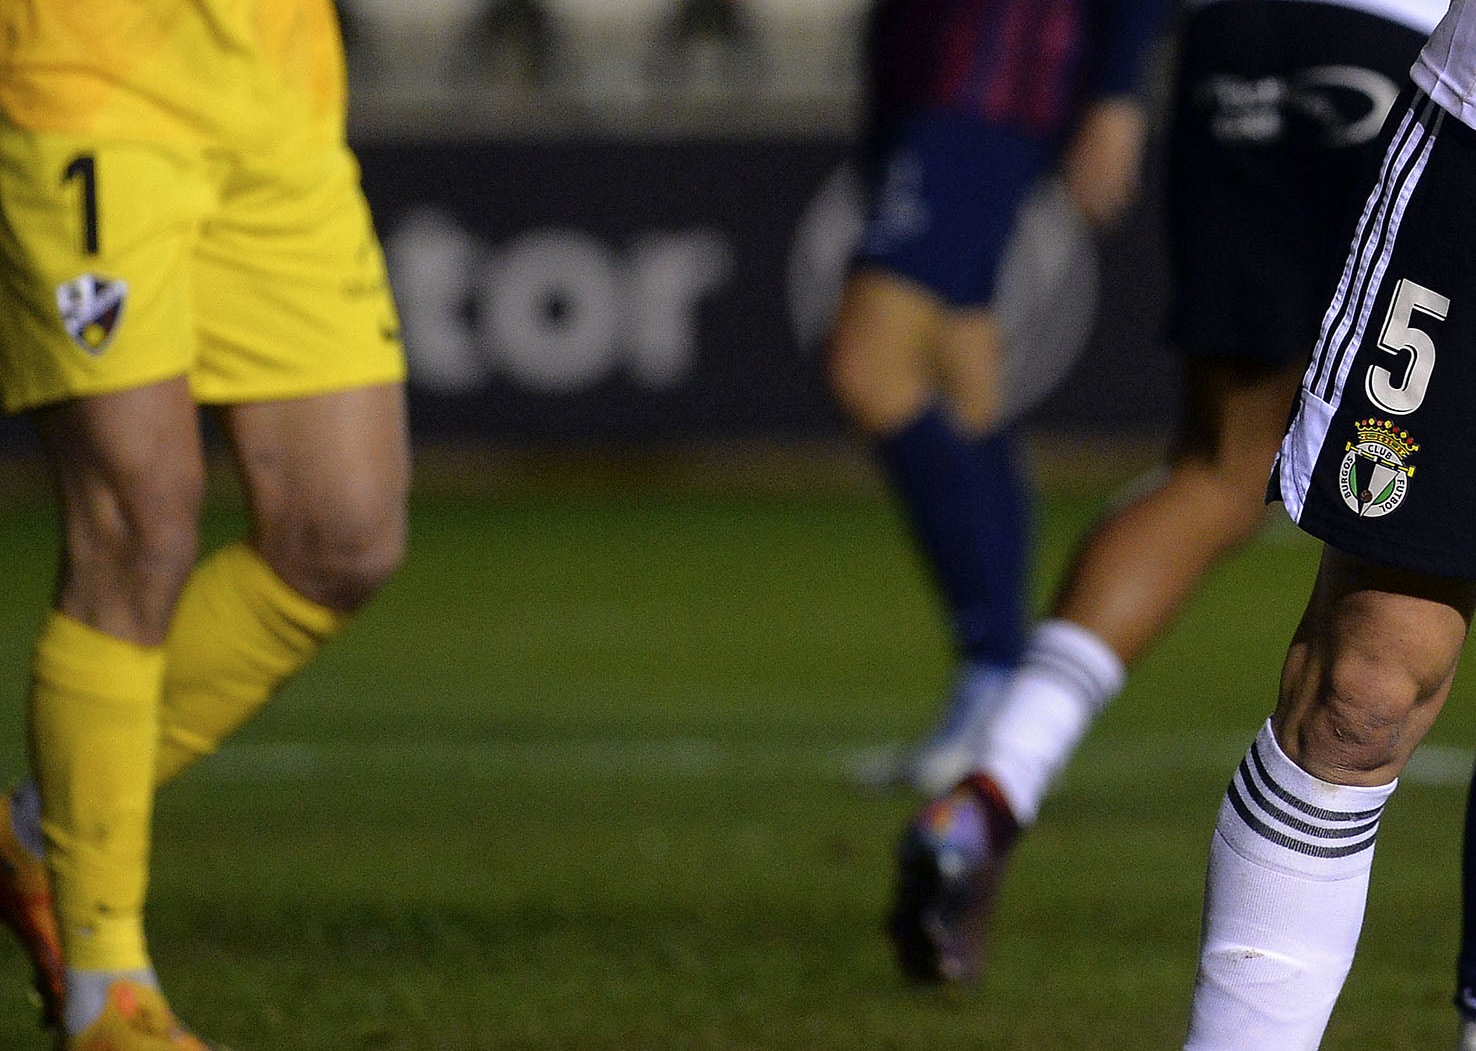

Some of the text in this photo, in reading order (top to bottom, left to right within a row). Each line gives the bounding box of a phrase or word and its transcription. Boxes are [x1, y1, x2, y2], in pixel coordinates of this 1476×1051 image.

[62, 152, 98, 255] 1
[1364, 278, 1450, 416] 5
[1367, 444, 1393, 460] CLUB
[1341, 455, 1354, 499] BURGOS
[1379, 479, 1405, 513] FUTBOL
